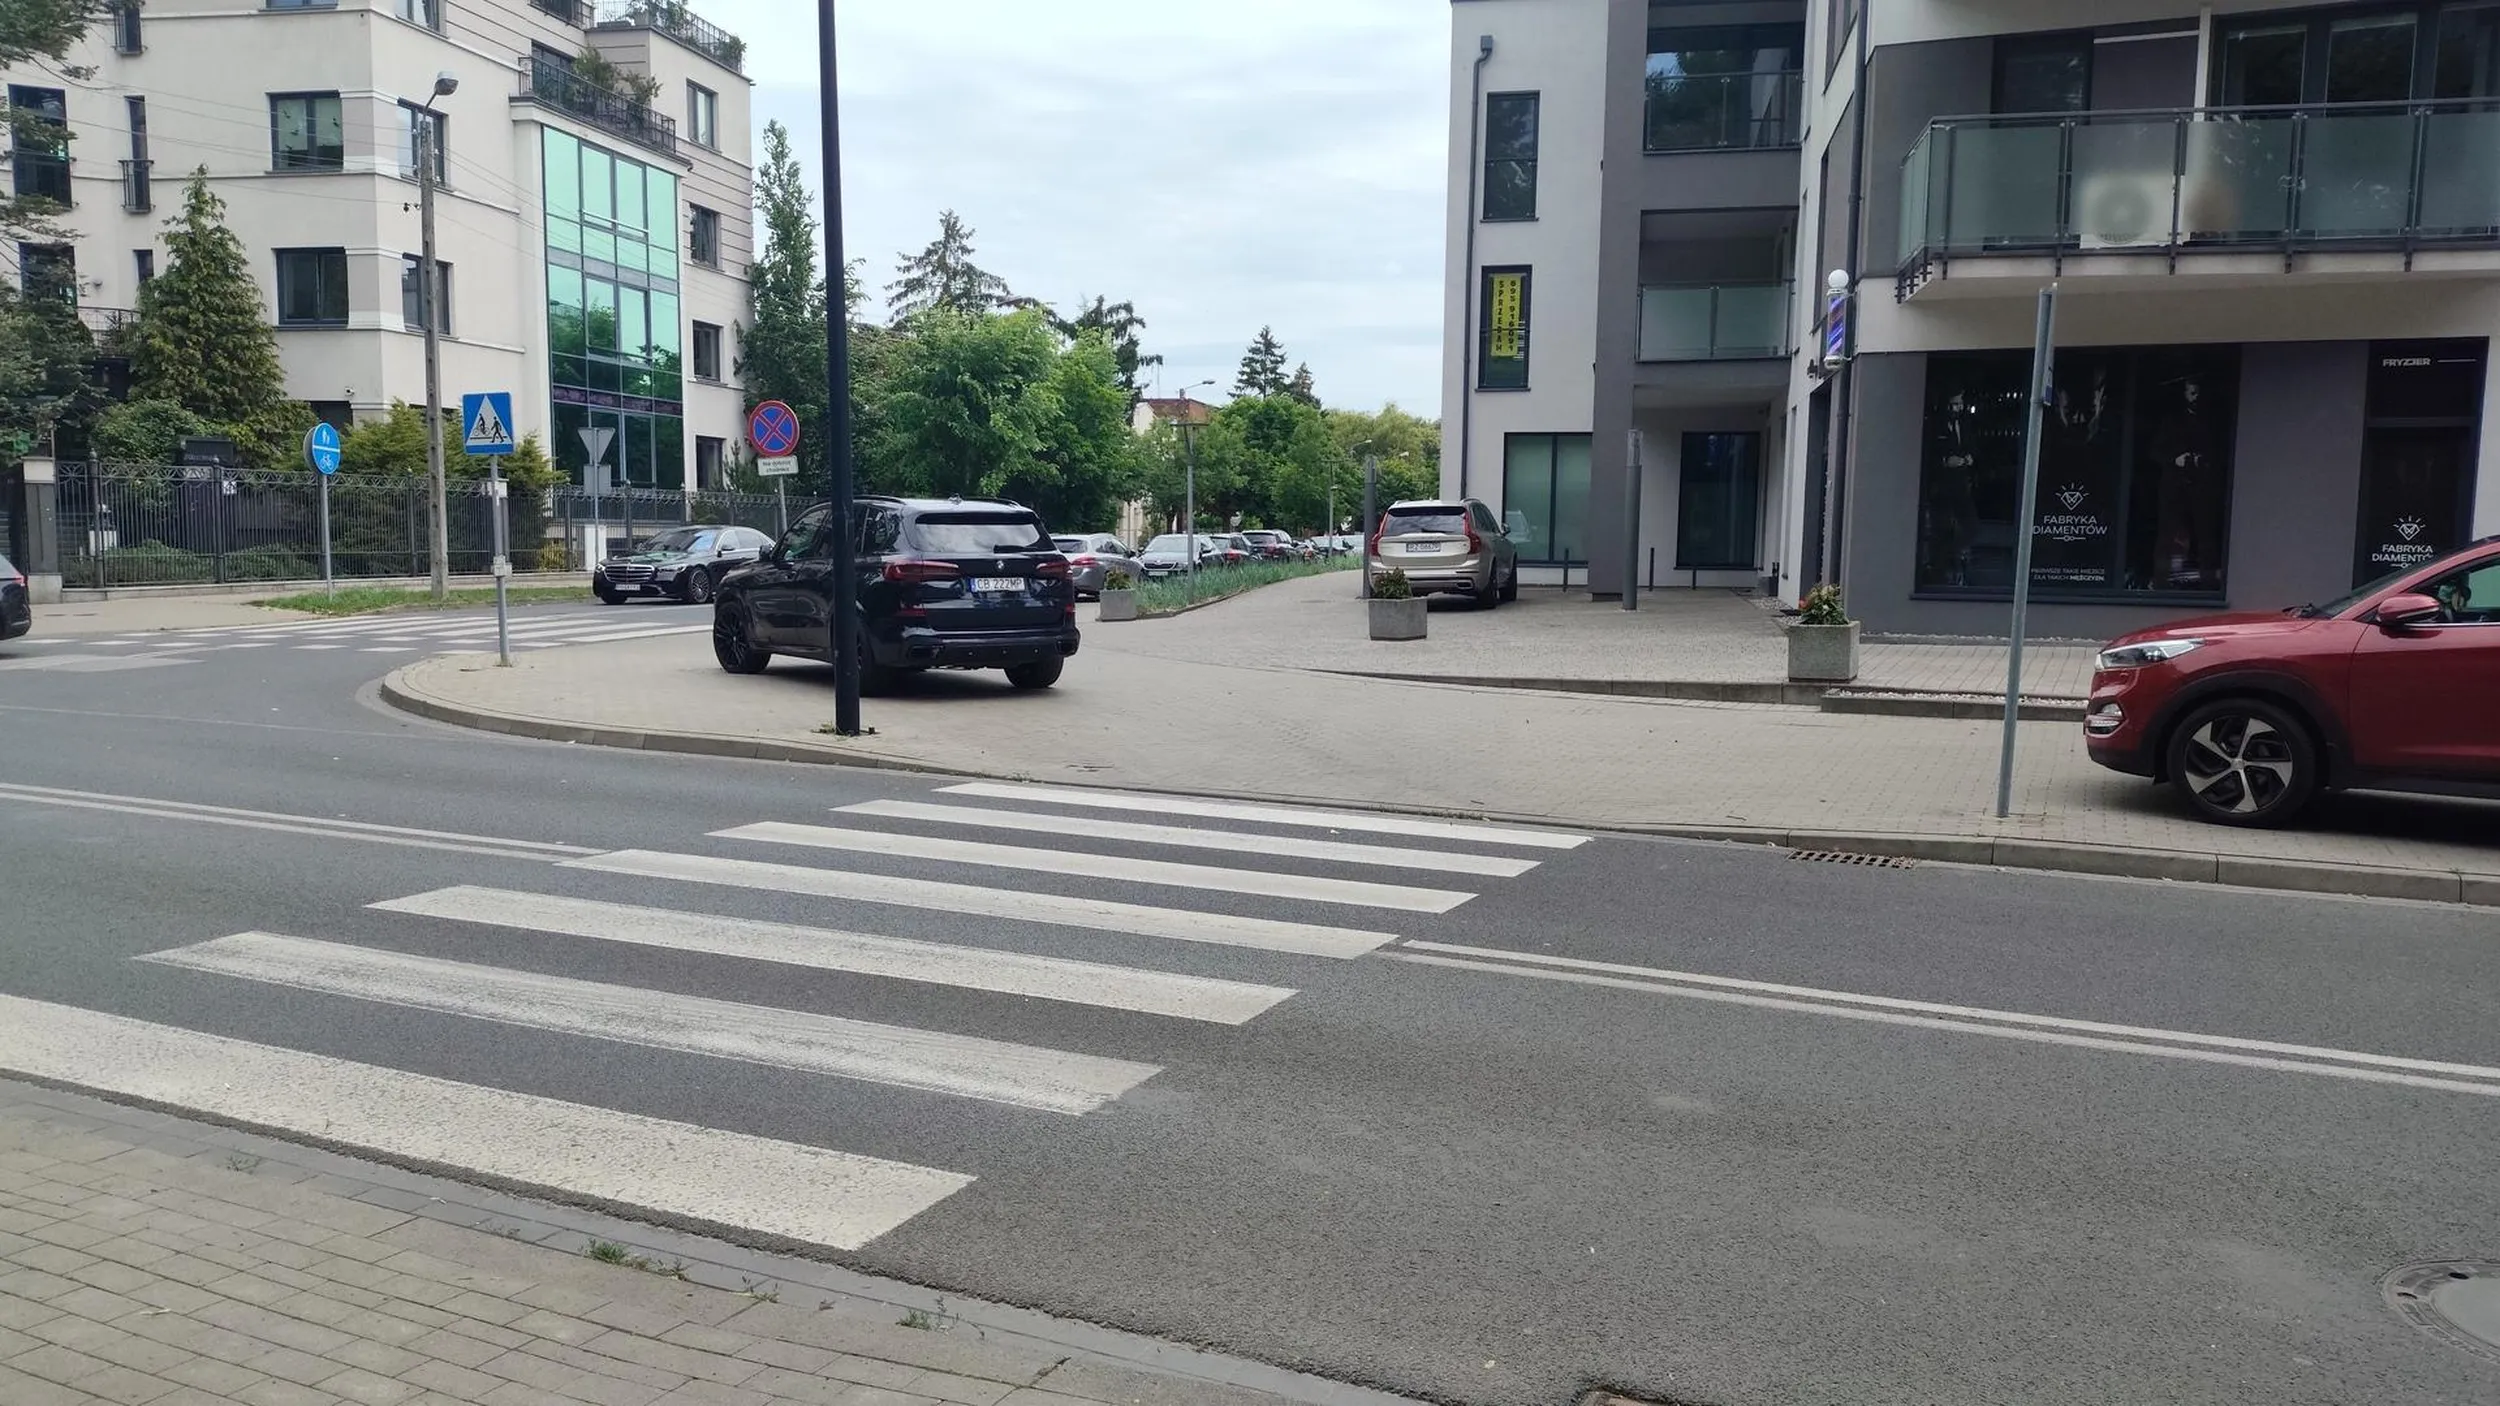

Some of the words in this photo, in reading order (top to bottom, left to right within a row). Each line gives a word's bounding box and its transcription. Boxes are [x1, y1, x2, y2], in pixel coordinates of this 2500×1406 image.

[1496, 280, 1504, 351] SPRZEDAM
[2383, 358, 2431, 366] FRYZJER
[2043, 515, 2097, 524] FABRYKA
[2032, 524, 2107, 534] DIAMENTÓW
[2382, 545, 2433, 553] FABRYKA
[977, 578, 990, 589] CB
